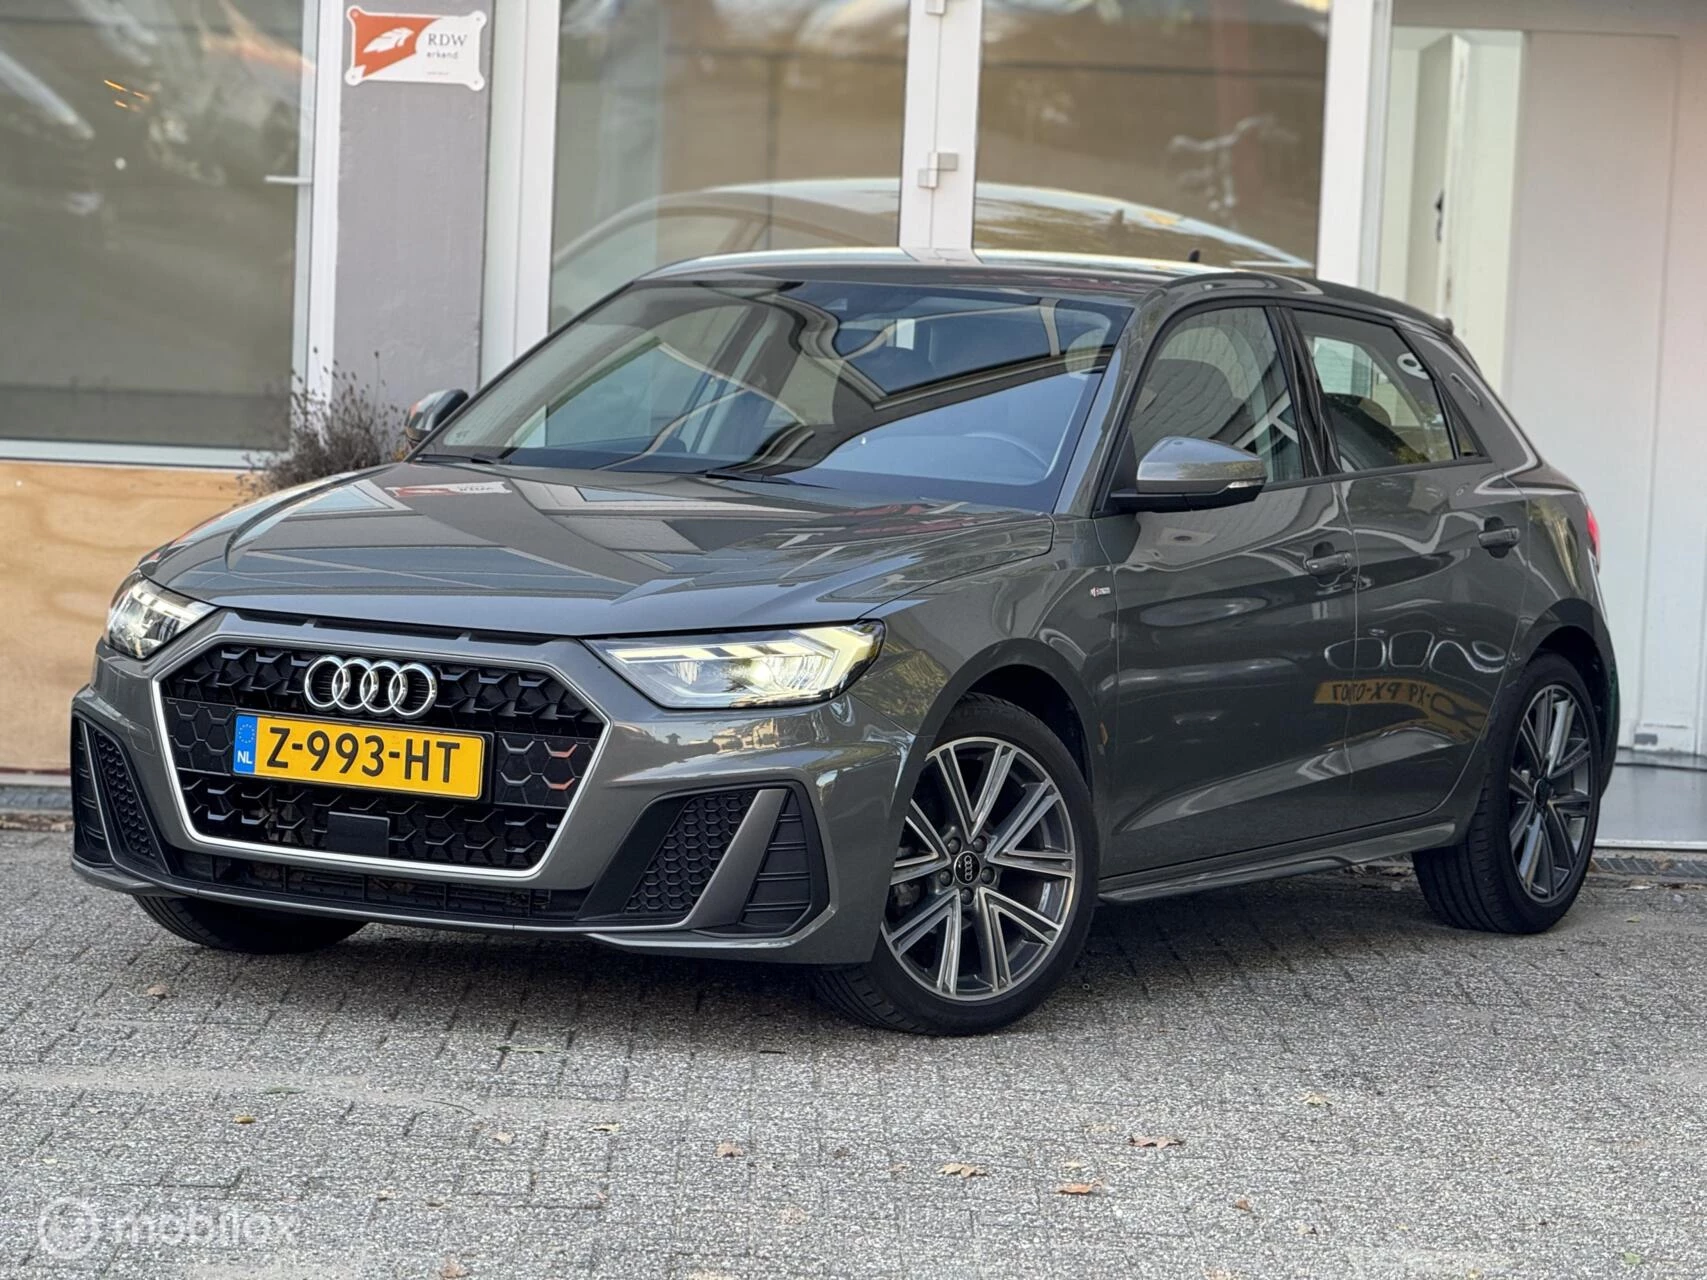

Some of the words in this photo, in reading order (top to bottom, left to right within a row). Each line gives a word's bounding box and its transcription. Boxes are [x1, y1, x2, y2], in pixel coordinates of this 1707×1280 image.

[428, 33, 468, 46] RDW
[237, 750, 253, 765] NL
[267, 727, 461, 783] Z-993-HT
